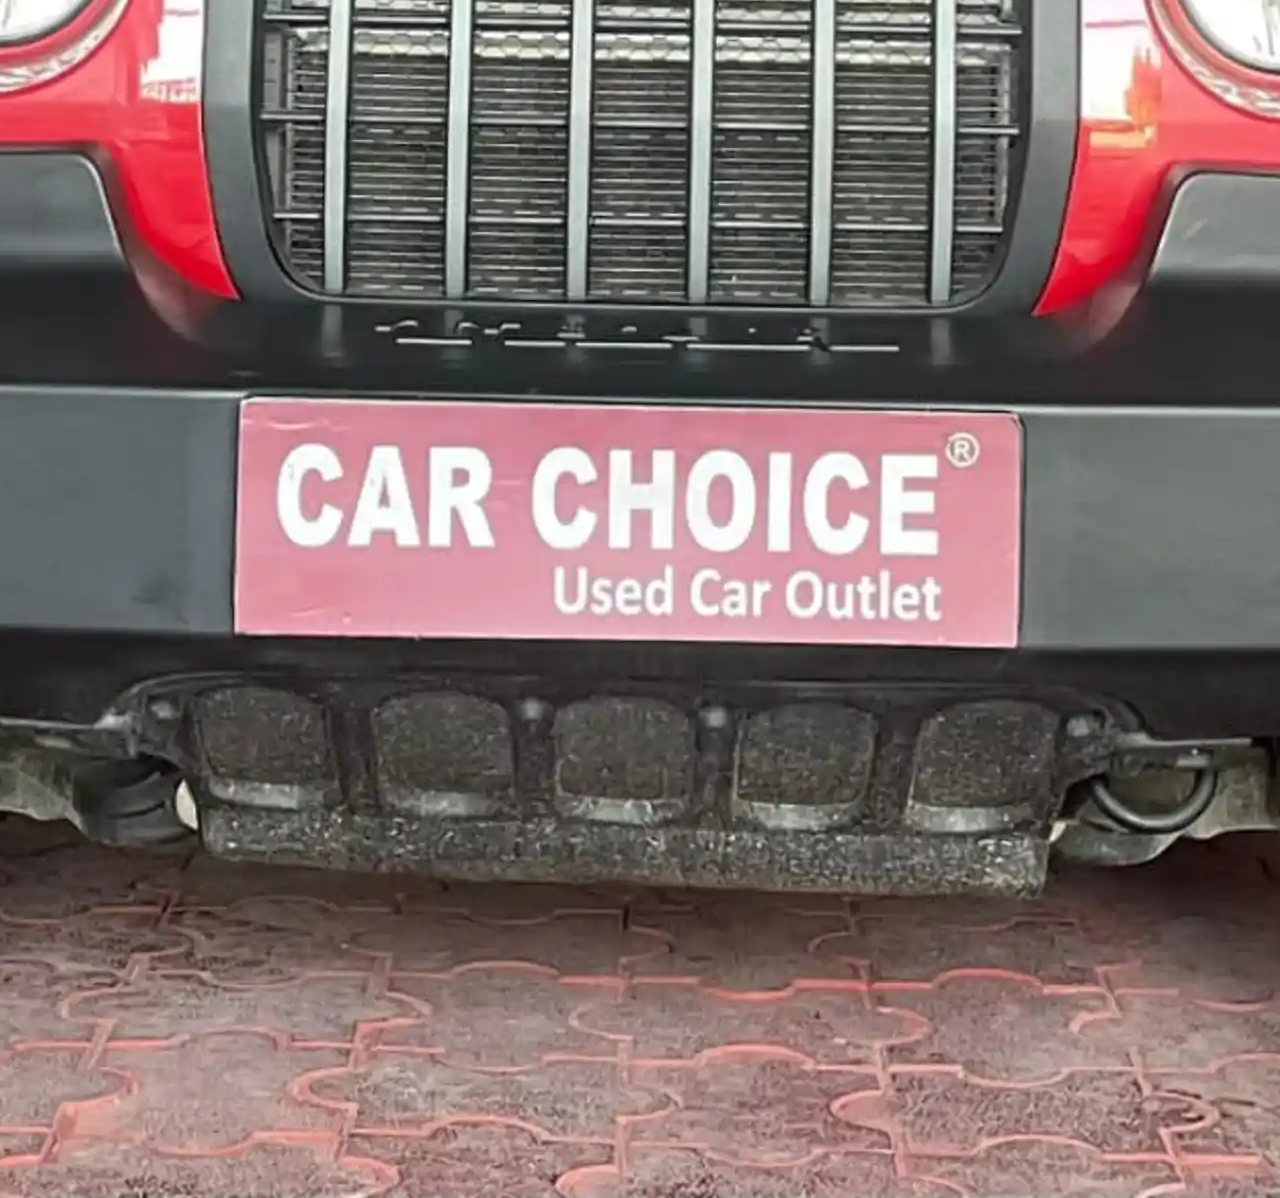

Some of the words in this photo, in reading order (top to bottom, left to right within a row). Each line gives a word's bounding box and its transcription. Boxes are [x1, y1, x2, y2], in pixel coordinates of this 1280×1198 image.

[276, 444, 495, 548] CAR
[553, 565, 675, 616] Used
[690, 569, 772, 619] Car
[785, 568, 942, 622] Outlet
